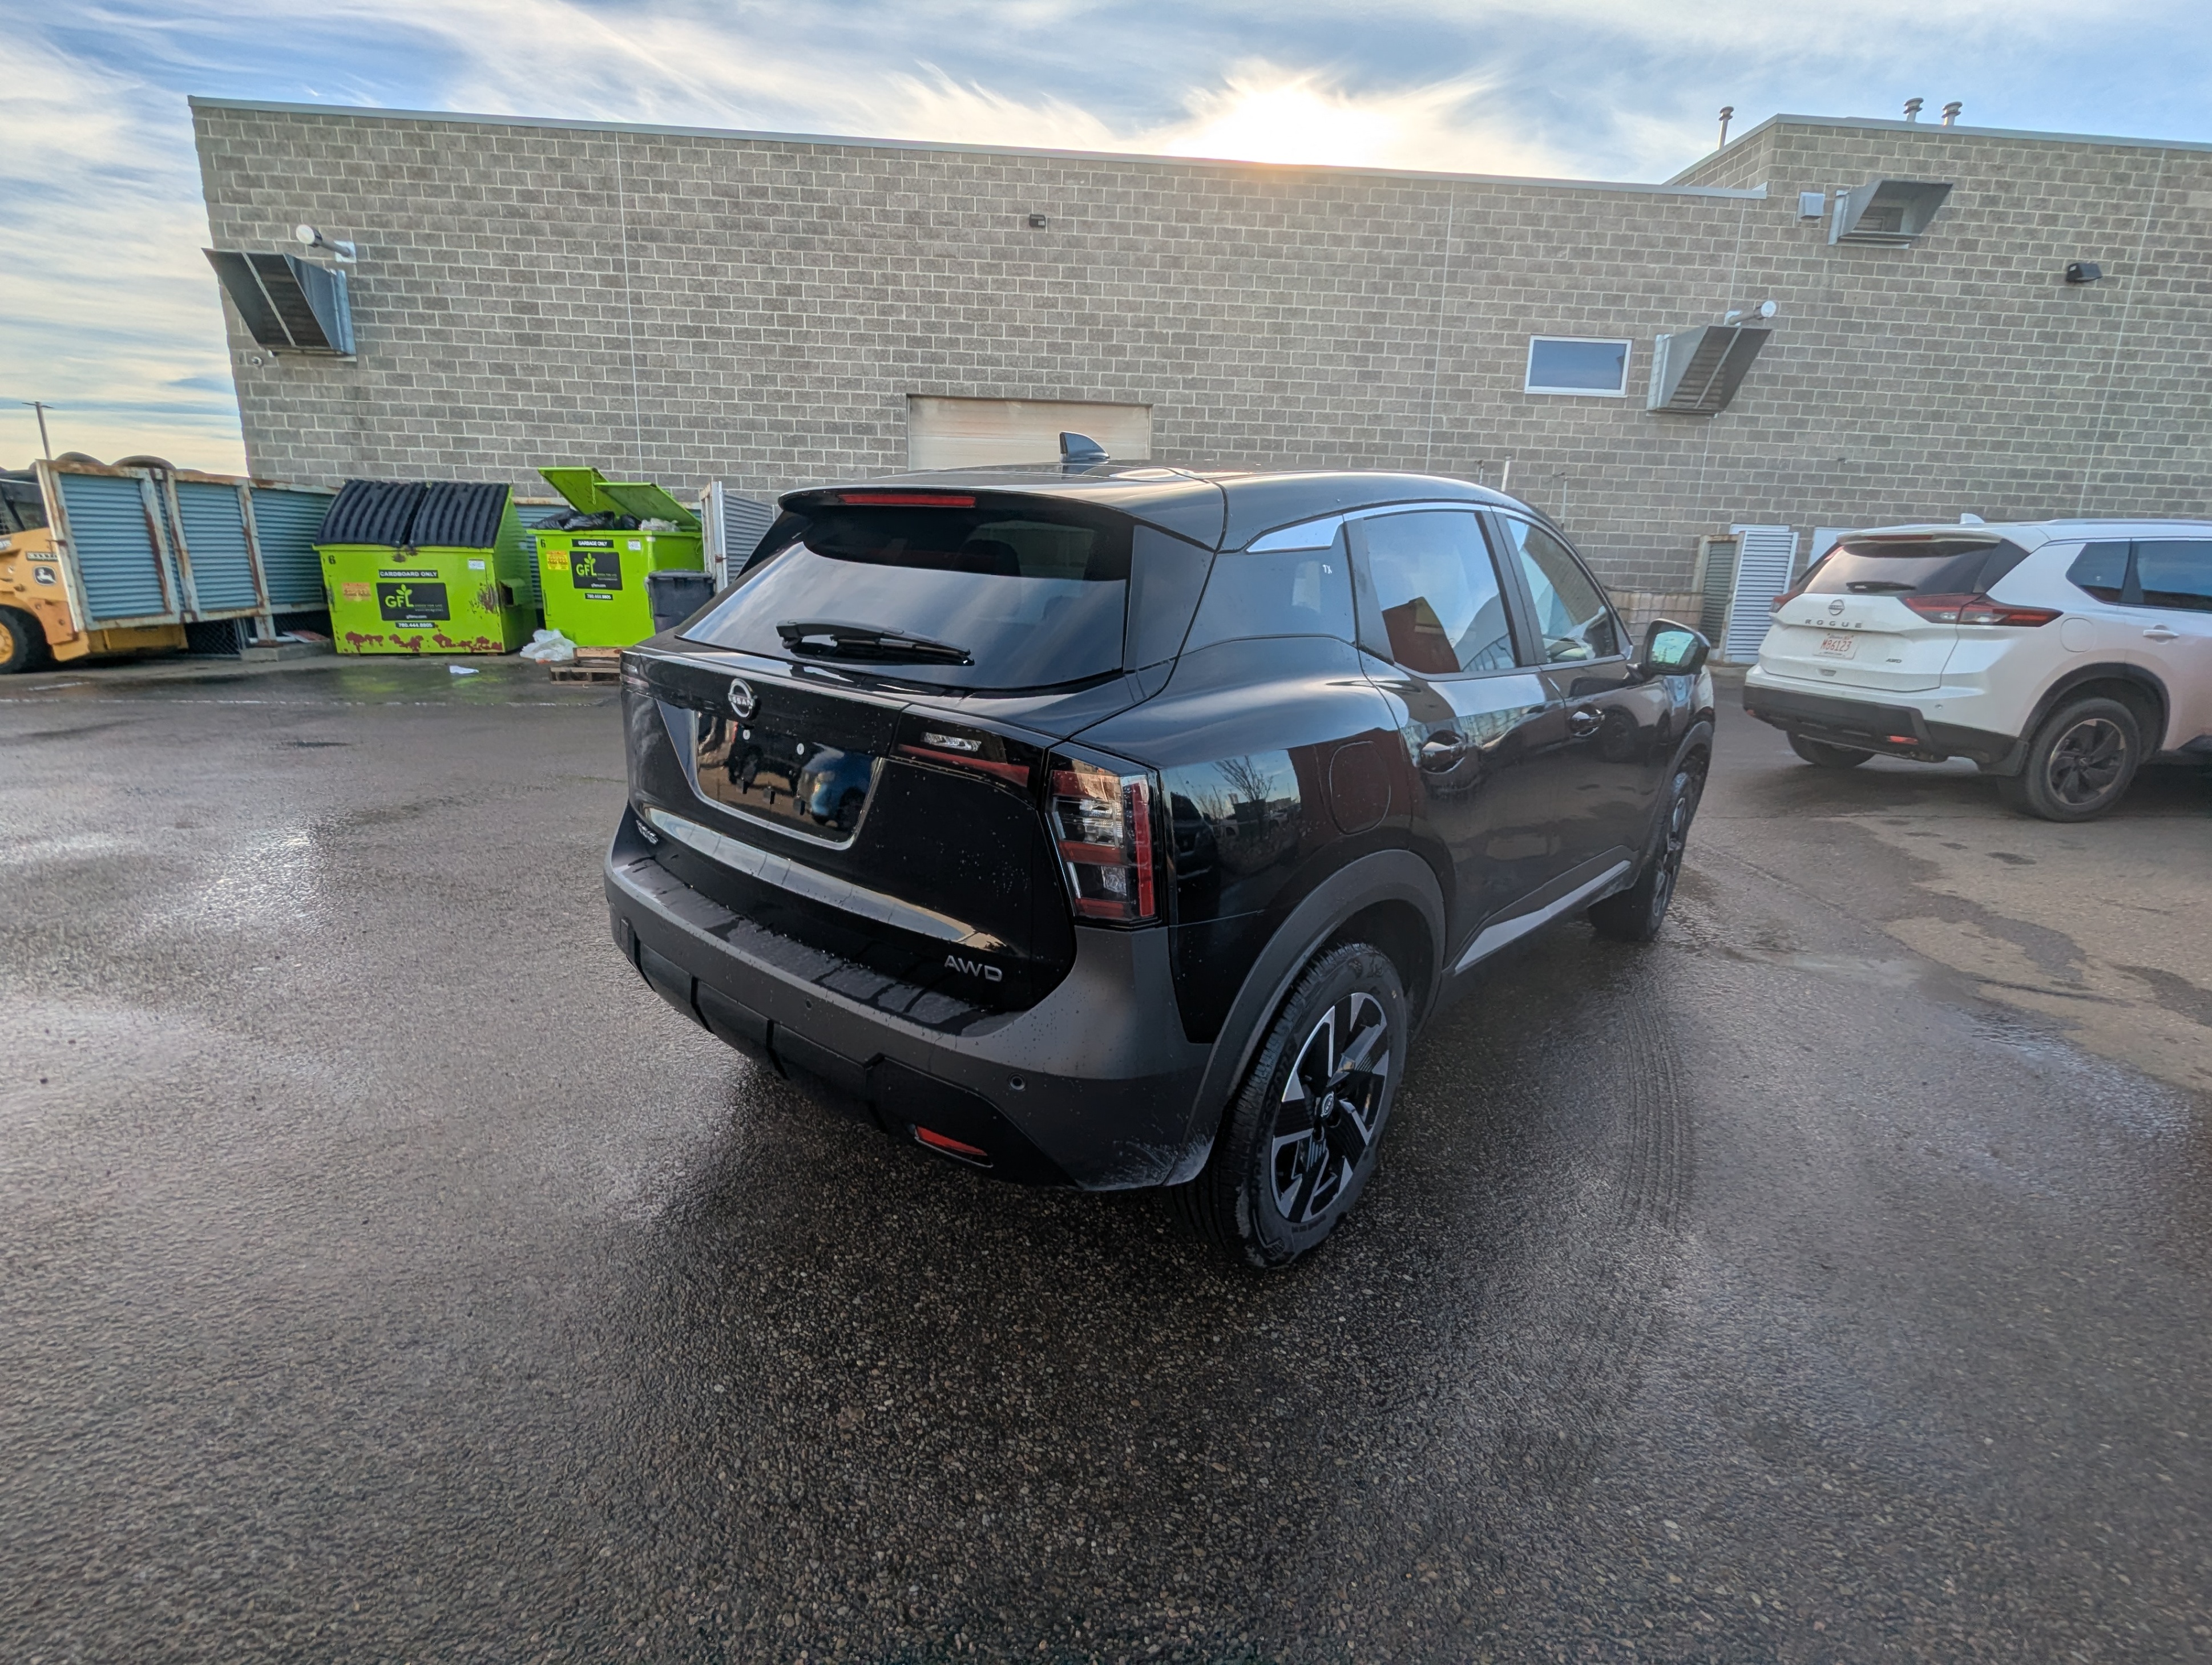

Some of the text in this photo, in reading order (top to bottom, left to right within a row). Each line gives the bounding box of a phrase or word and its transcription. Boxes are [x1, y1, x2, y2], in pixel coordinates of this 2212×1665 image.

[540, 539, 546, 548] 6
[576, 560, 598, 576] GFL
[385, 589, 414, 608] GFL
[1805, 619, 1862, 628] ROGUE
[944, 955, 1003, 982] AWD
